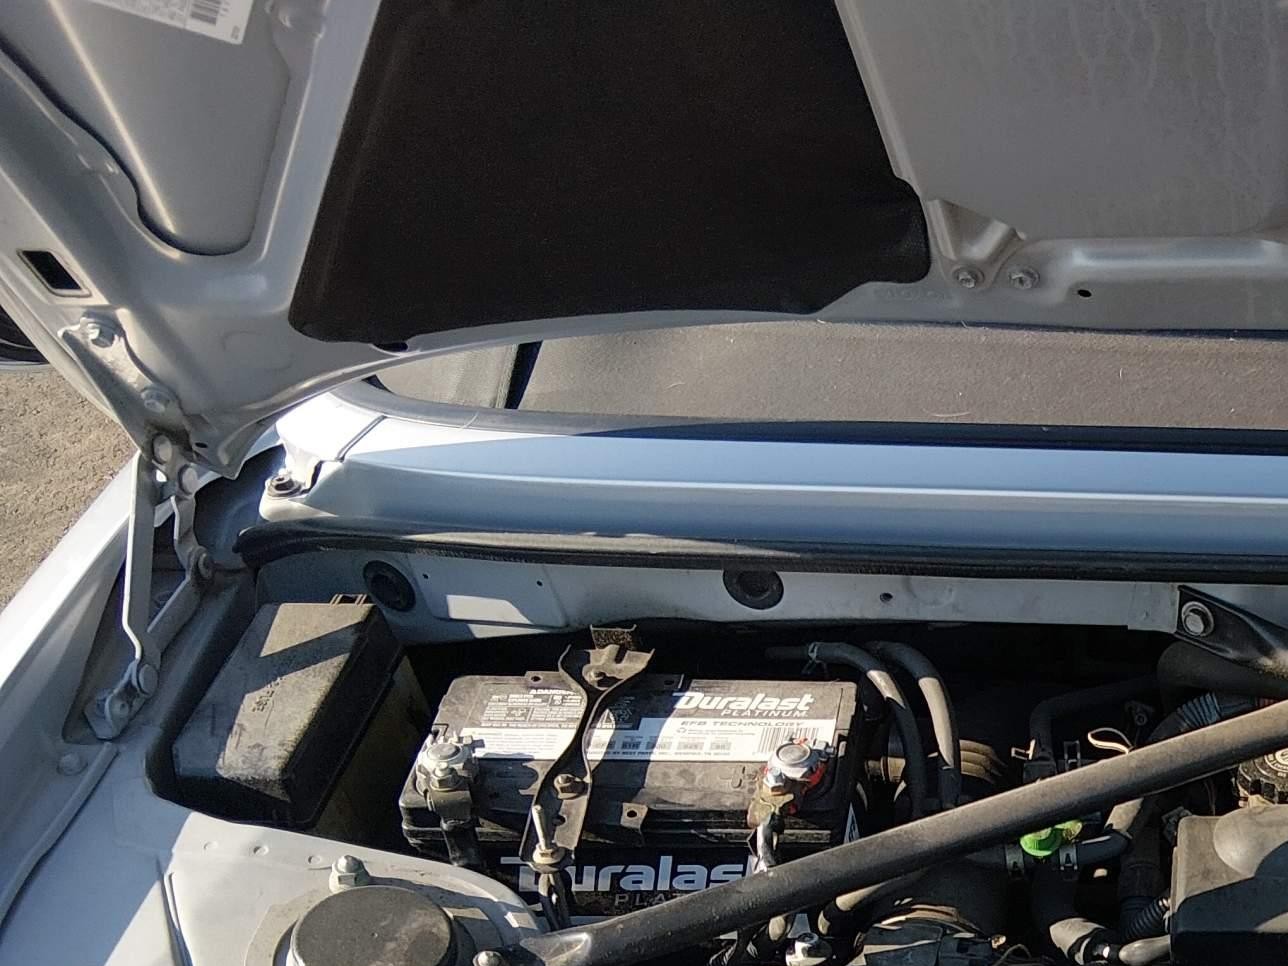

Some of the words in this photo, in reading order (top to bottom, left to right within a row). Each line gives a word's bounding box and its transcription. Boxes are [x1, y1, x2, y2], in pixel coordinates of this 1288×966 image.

[673, 691, 816, 711] Duralast
[721, 709, 808, 717] PLATINUM
[712, 720, 805, 728] TECHNOLOGY
[501, 856, 753, 892] Duralas
